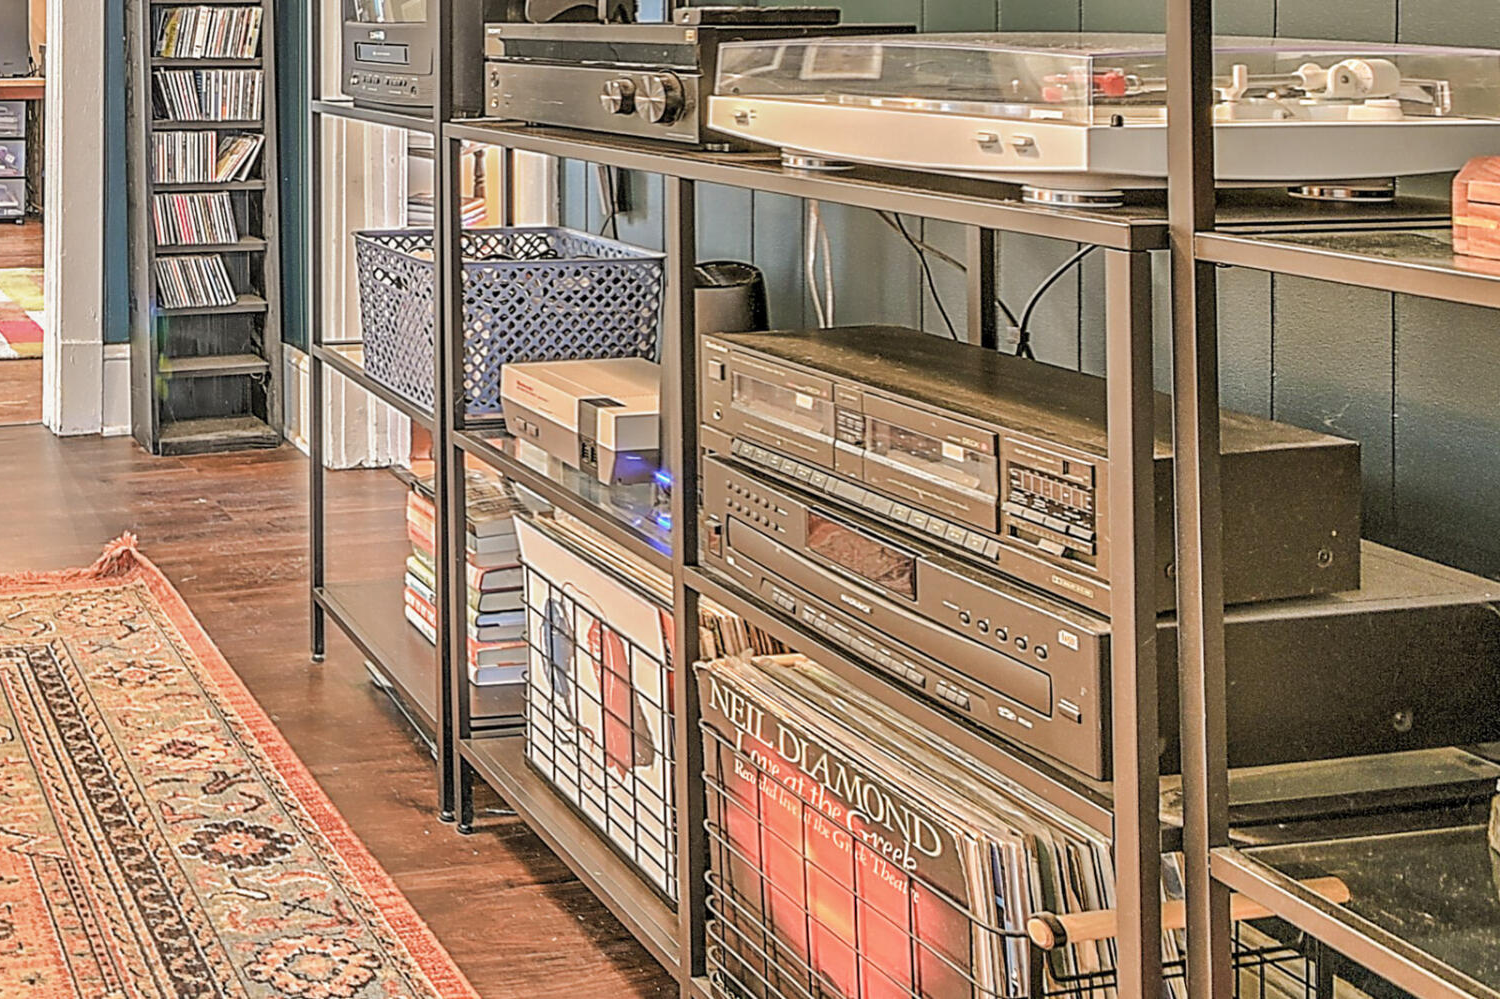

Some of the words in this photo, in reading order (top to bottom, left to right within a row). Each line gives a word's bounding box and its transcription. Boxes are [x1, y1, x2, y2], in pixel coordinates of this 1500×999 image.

[709, 676, 774, 749] NEIL
[776, 722, 943, 858] DIAMOND
[734, 758, 778, 801] Recoded
[809, 782, 843, 819] the
